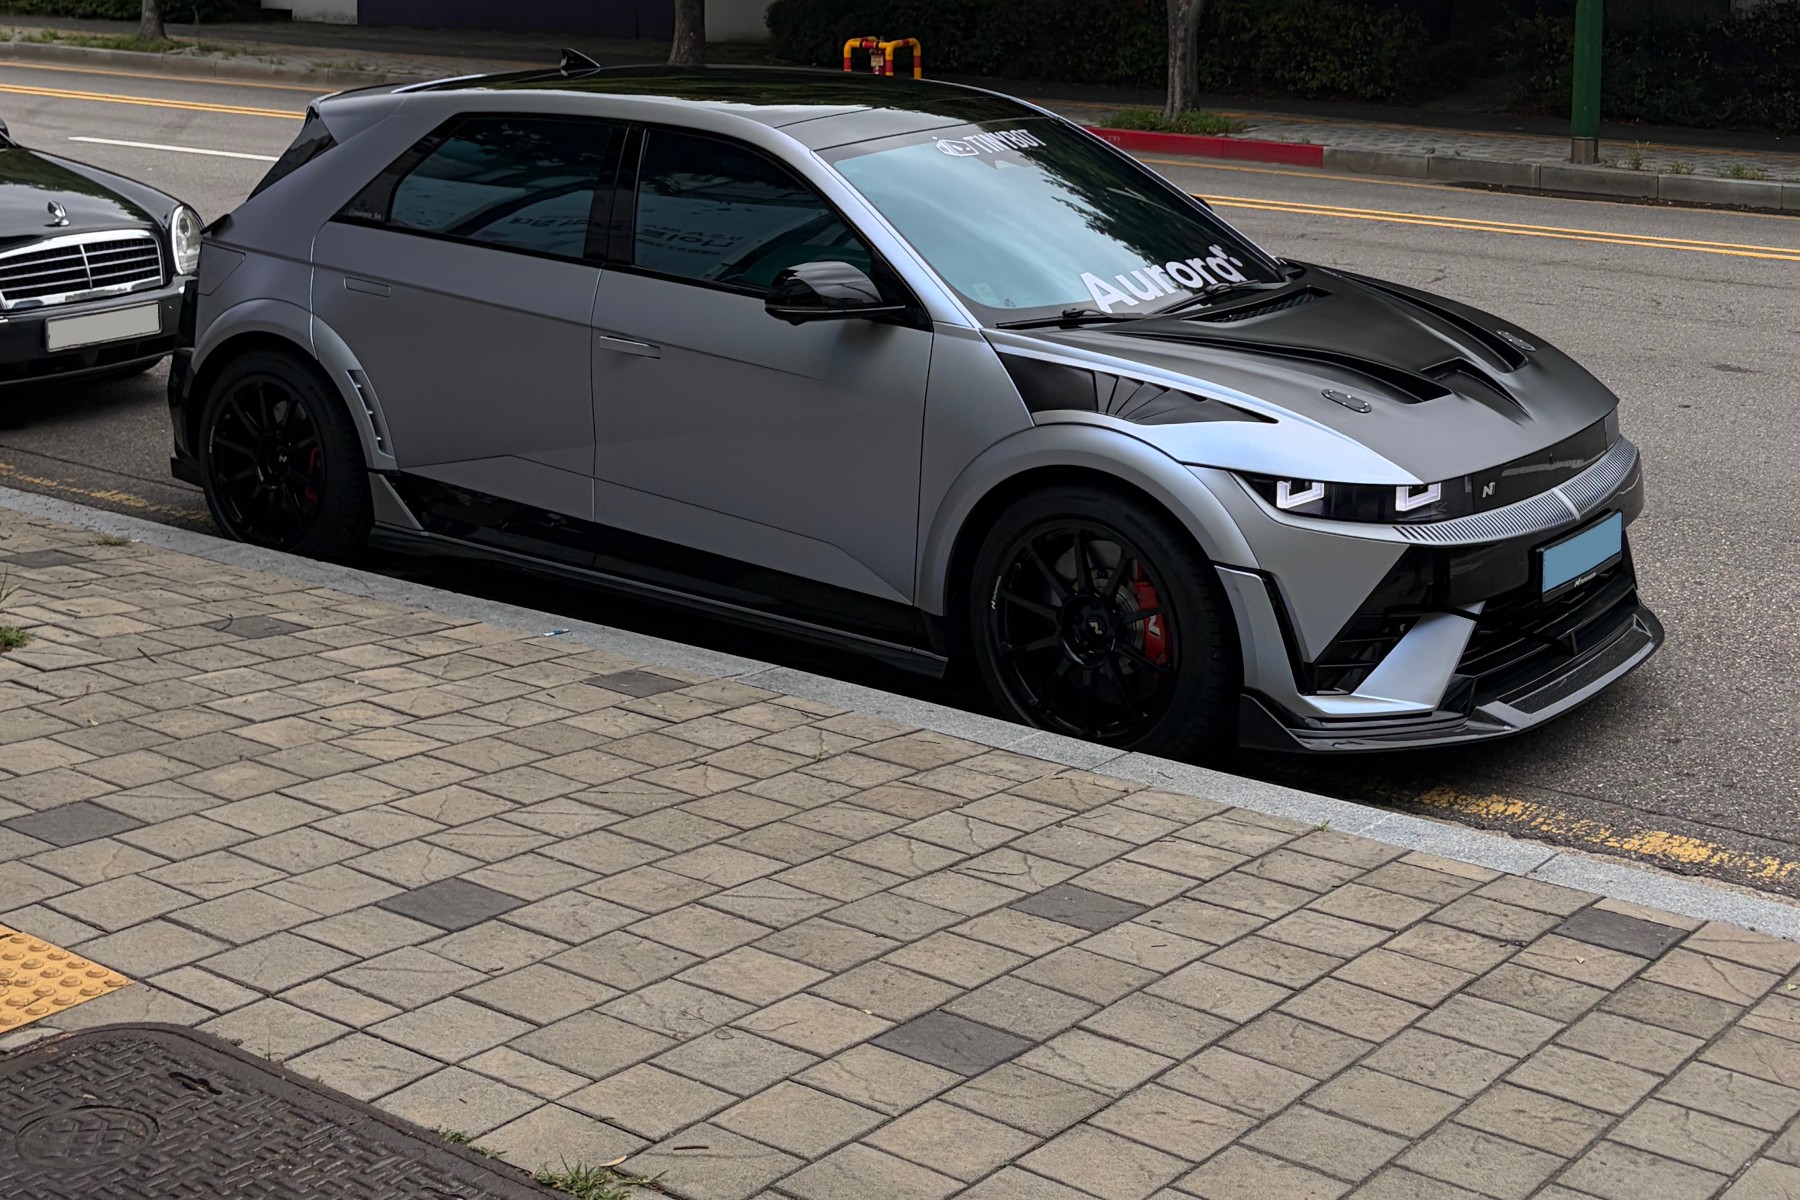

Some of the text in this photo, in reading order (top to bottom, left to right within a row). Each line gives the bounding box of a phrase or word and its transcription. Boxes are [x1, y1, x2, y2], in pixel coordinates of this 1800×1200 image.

[963, 128, 1047, 154] TINYBOT
[1080, 255, 1248, 314] Aurora
[1481, 481, 1497, 498] N
